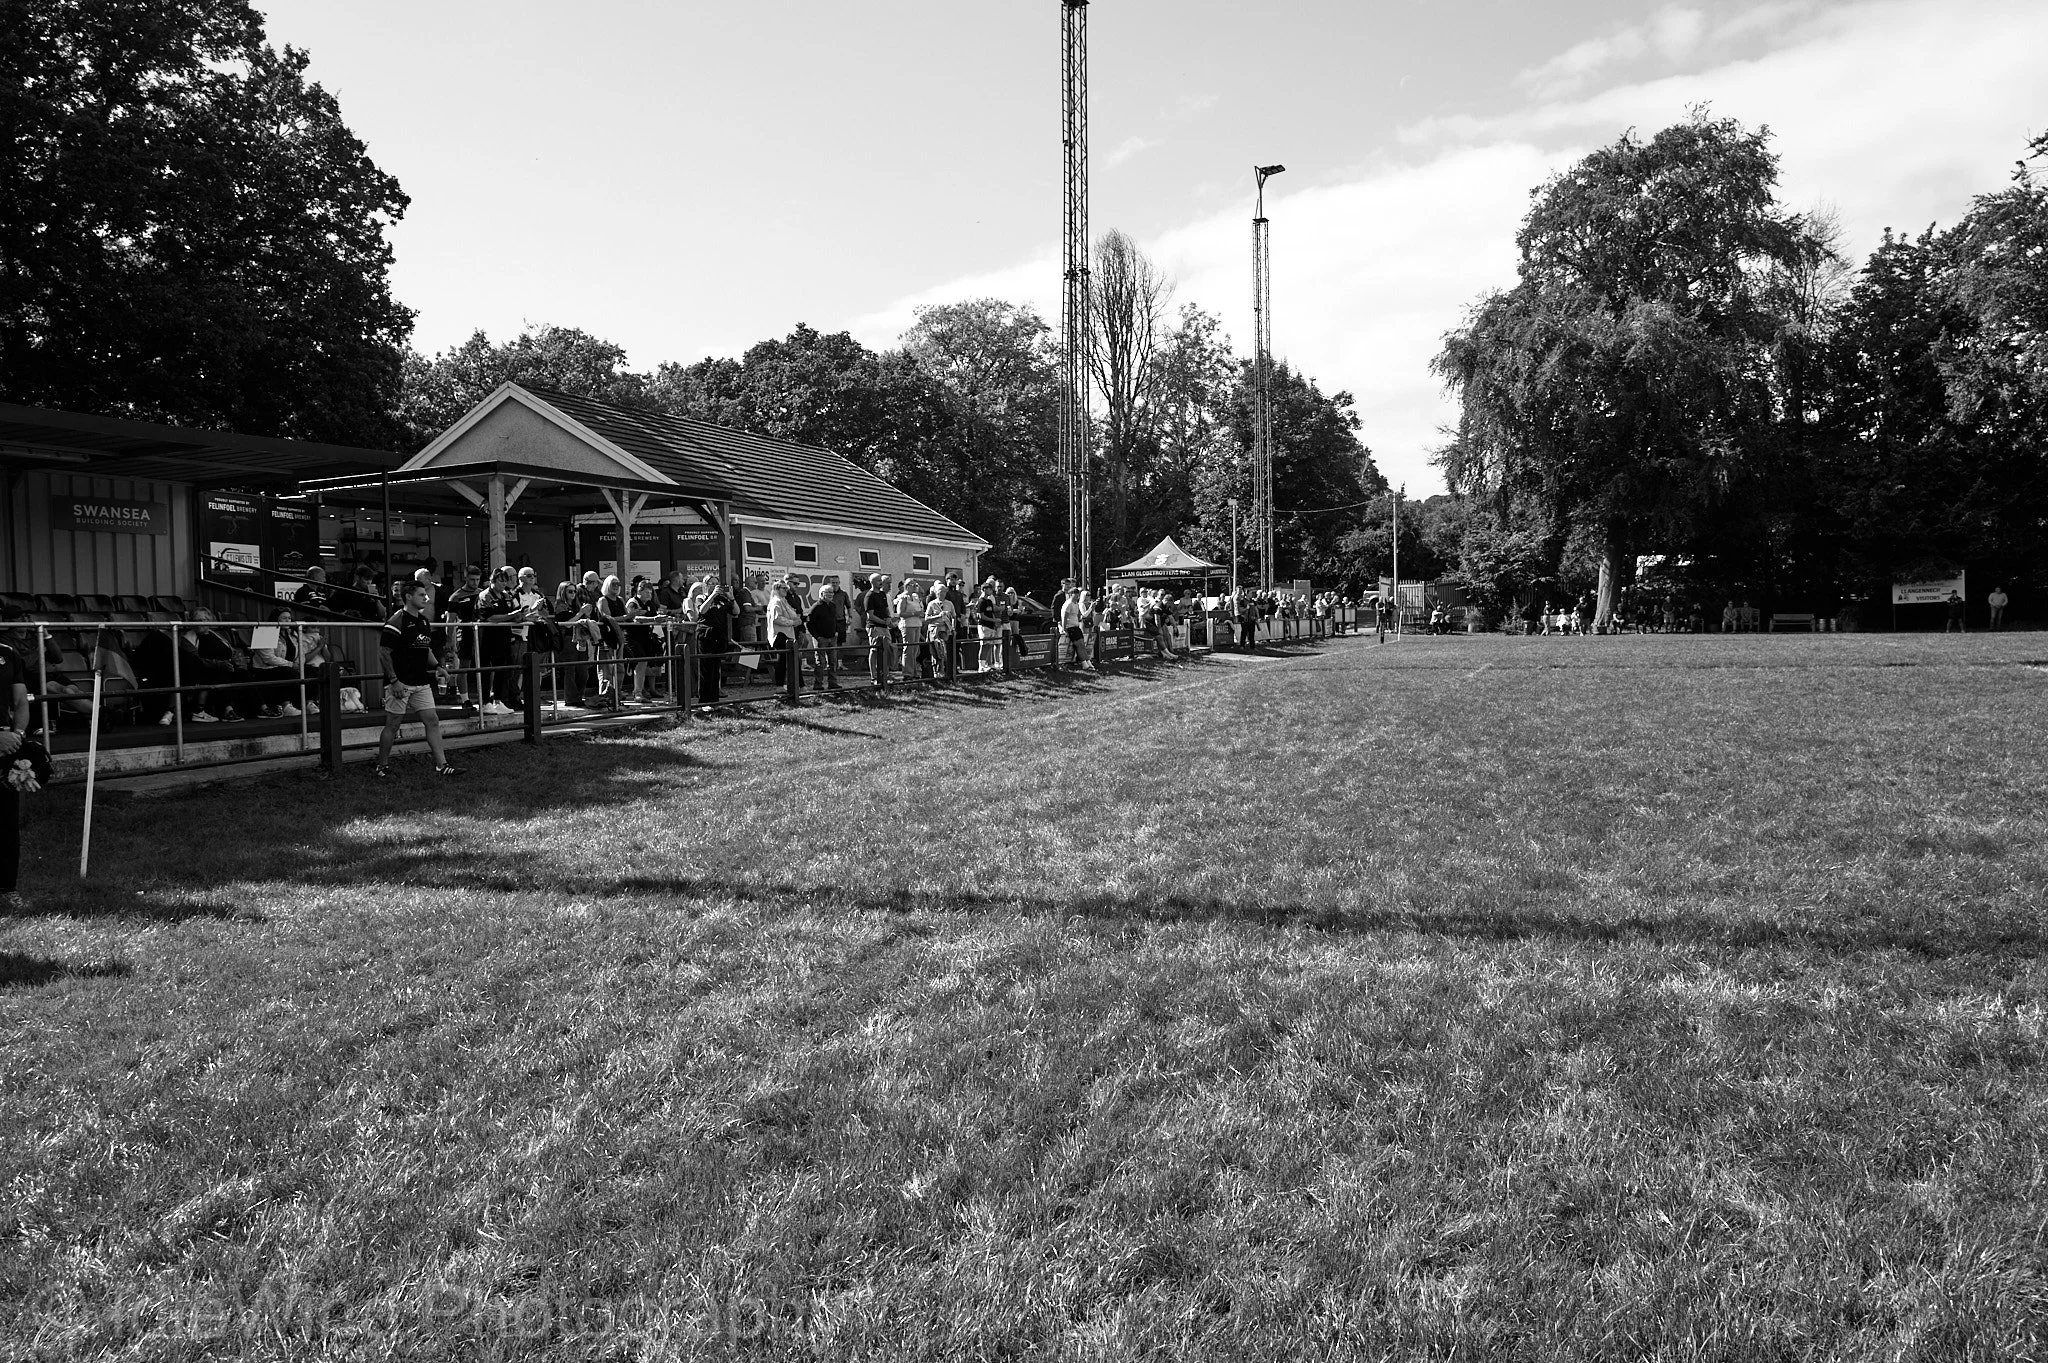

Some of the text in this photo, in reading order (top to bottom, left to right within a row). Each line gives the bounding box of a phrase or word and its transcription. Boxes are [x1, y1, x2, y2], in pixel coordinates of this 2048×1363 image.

[73, 504, 151, 520] SWANSEA
[208, 502, 236, 512] FELINFOEL
[271, 510, 294, 520] FELINFOEL
[76, 517, 148, 527] BUILDING SOCIETY
[687, 563, 720, 571] BEECHWO
